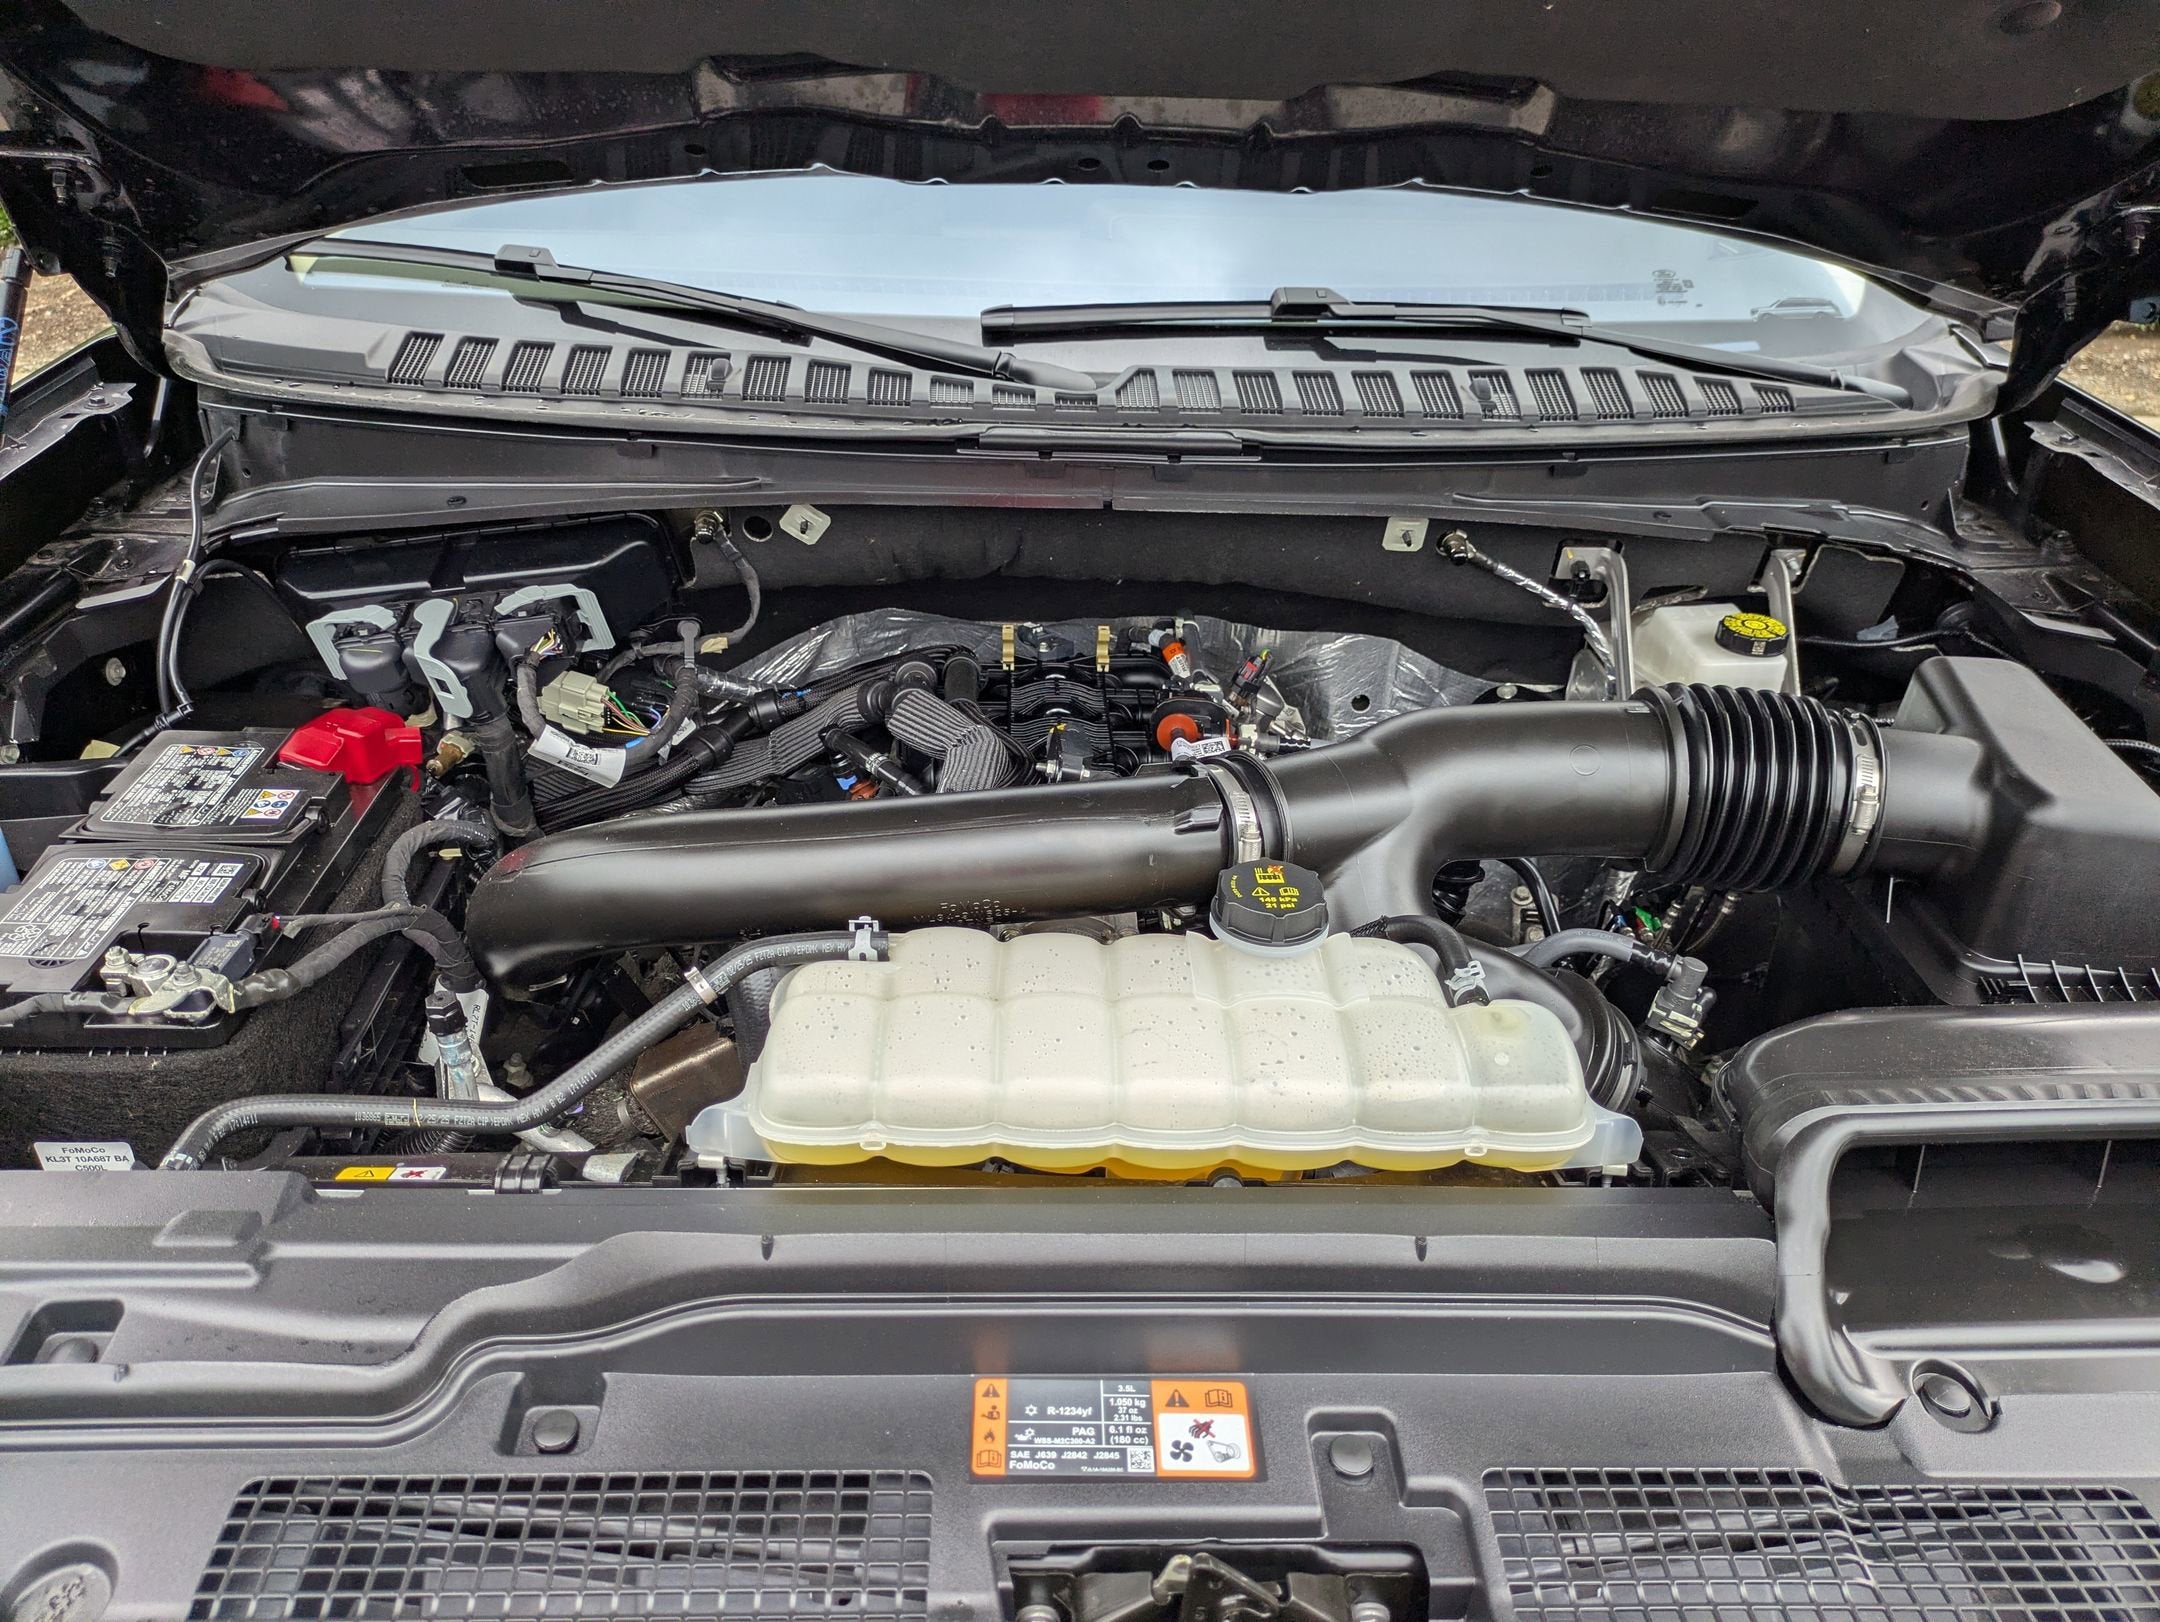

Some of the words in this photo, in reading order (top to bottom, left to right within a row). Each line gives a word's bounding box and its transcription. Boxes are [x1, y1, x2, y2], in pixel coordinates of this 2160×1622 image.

[1117, 1385, 1136, 1393] 3.5L
[1109, 1398, 1132, 1407] 1.050
[1134, 1398, 1146, 1409] kg
[1047, 1406, 1093, 1417] R-1234yf
[1113, 1414, 1129, 1422] 2.31
[1072, 1427, 1096, 1436] PAG
[1109, 1425, 1124, 1434] 6.1
[1126, 1425, 1133, 1433] fl
[1133, 1436, 1149, 1445] cc)
[1010, 1450, 1031, 1459] SAE
[1034, 1451, 1057, 1459] J639
[1061, 1451, 1088, 1459] J2842
[1093, 1452, 1120, 1460] J2845
[1009, 1461, 1055, 1471] FoMoCo
